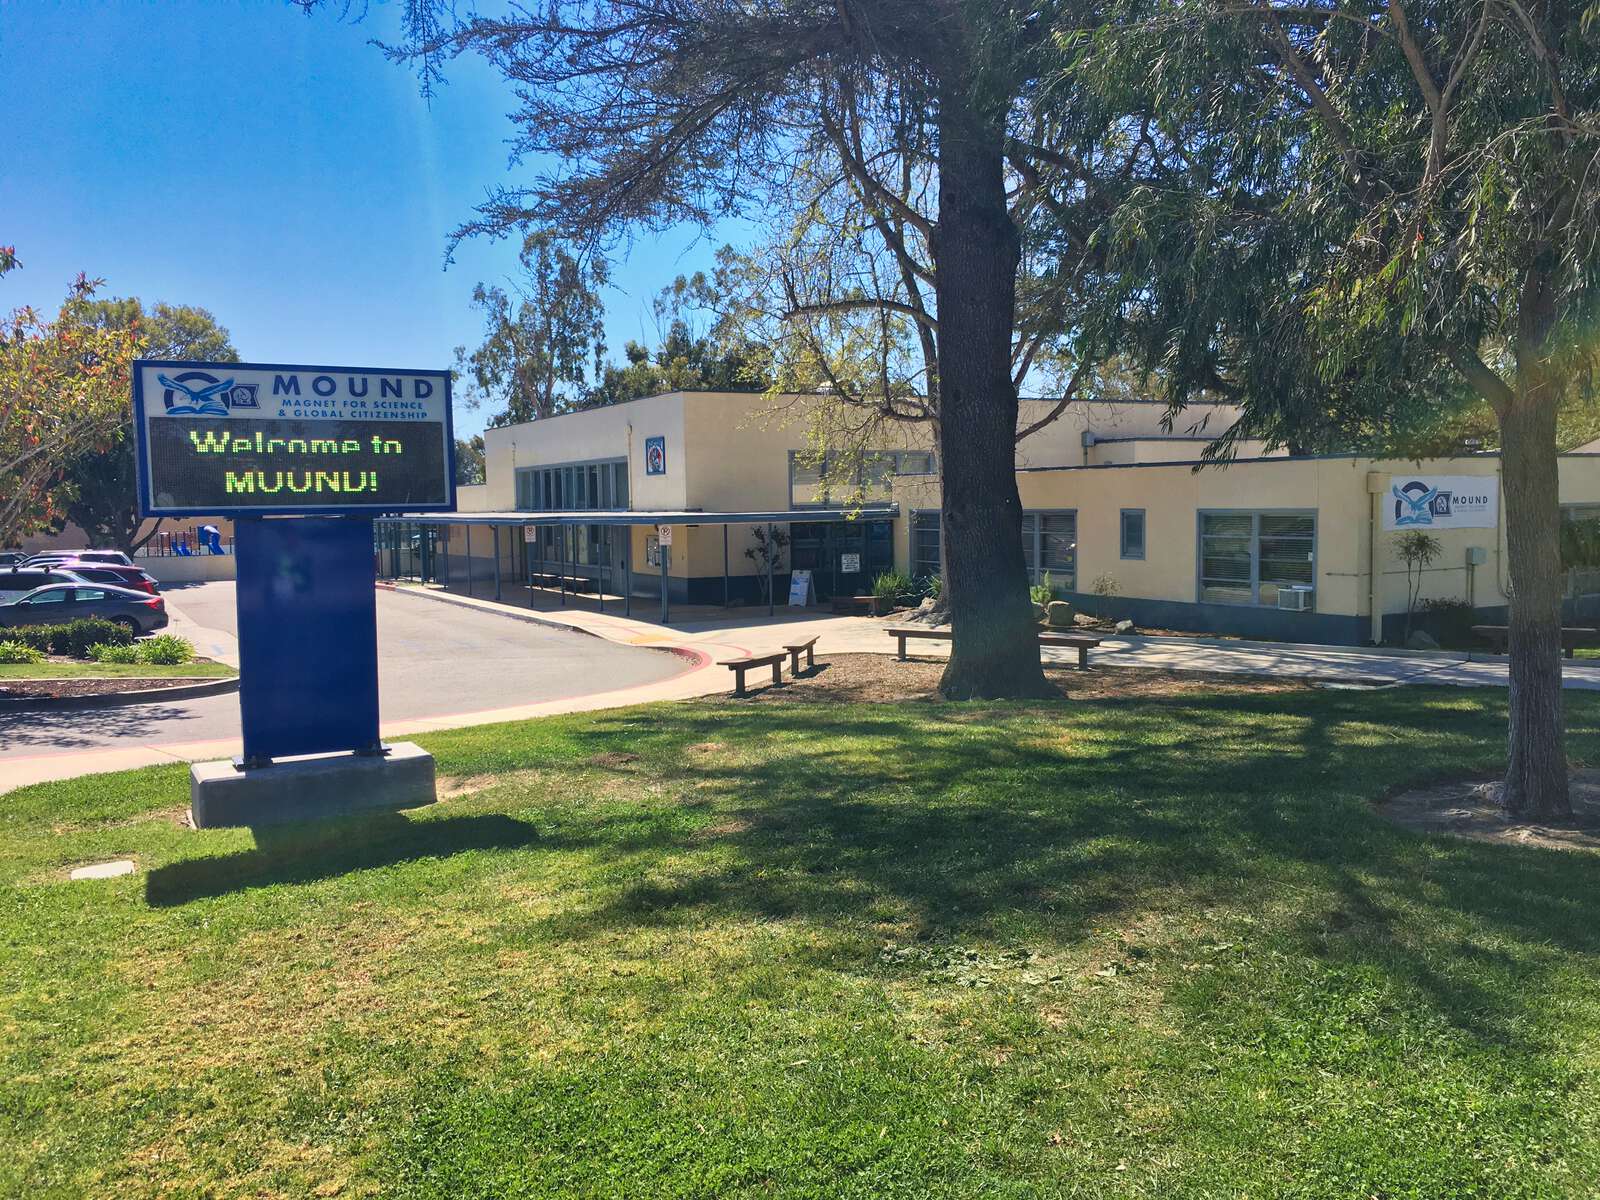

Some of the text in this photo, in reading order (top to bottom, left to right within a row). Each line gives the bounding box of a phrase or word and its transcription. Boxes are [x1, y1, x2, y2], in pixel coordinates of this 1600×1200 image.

[272, 374, 434, 398] MOUND
[281, 399, 423, 410] MAGNET FOR SCIENCE
[278, 409, 428, 419] & GLOBAL CITIZENSHIP
[1452, 496, 1488, 504] MOUND
